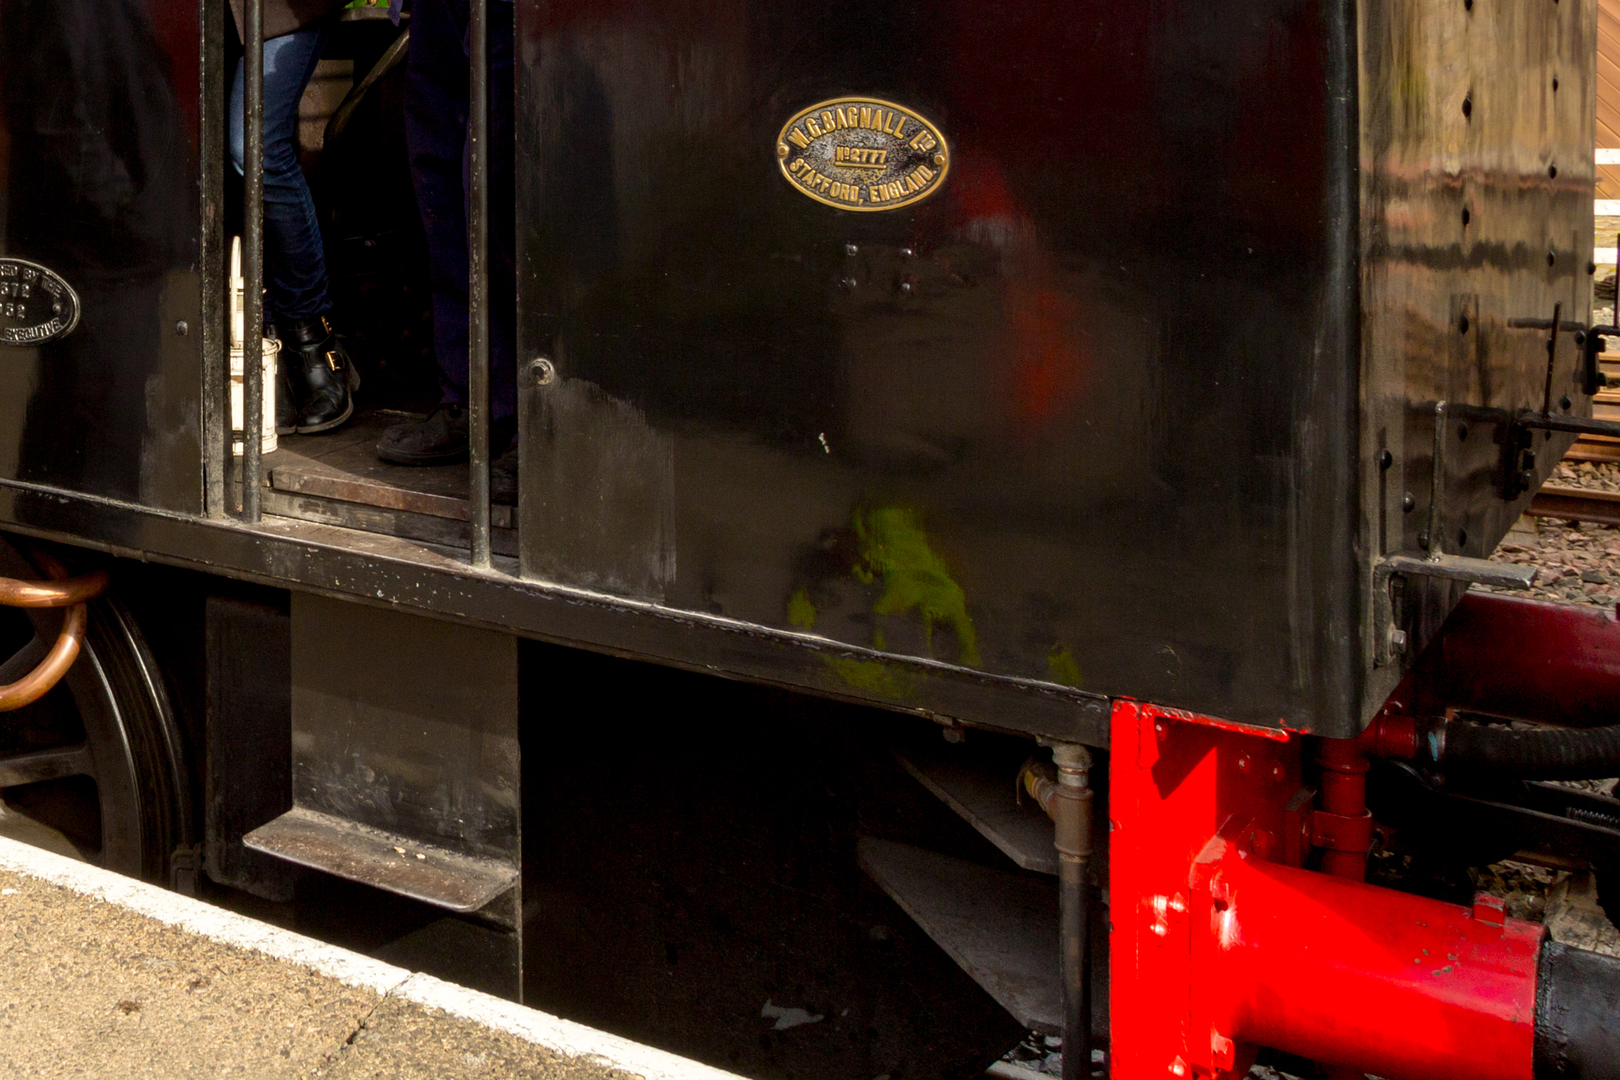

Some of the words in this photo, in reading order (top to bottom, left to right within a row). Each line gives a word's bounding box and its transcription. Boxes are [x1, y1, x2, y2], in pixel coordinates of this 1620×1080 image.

[789, 158, 864, 205] STAFFORD,
[869, 164, 938, 203] ENGLAND.
[23, 267, 39, 282] BY
[41, 275, 62, 298] THE
[4, 317, 64, 340] EXECUTIVE
